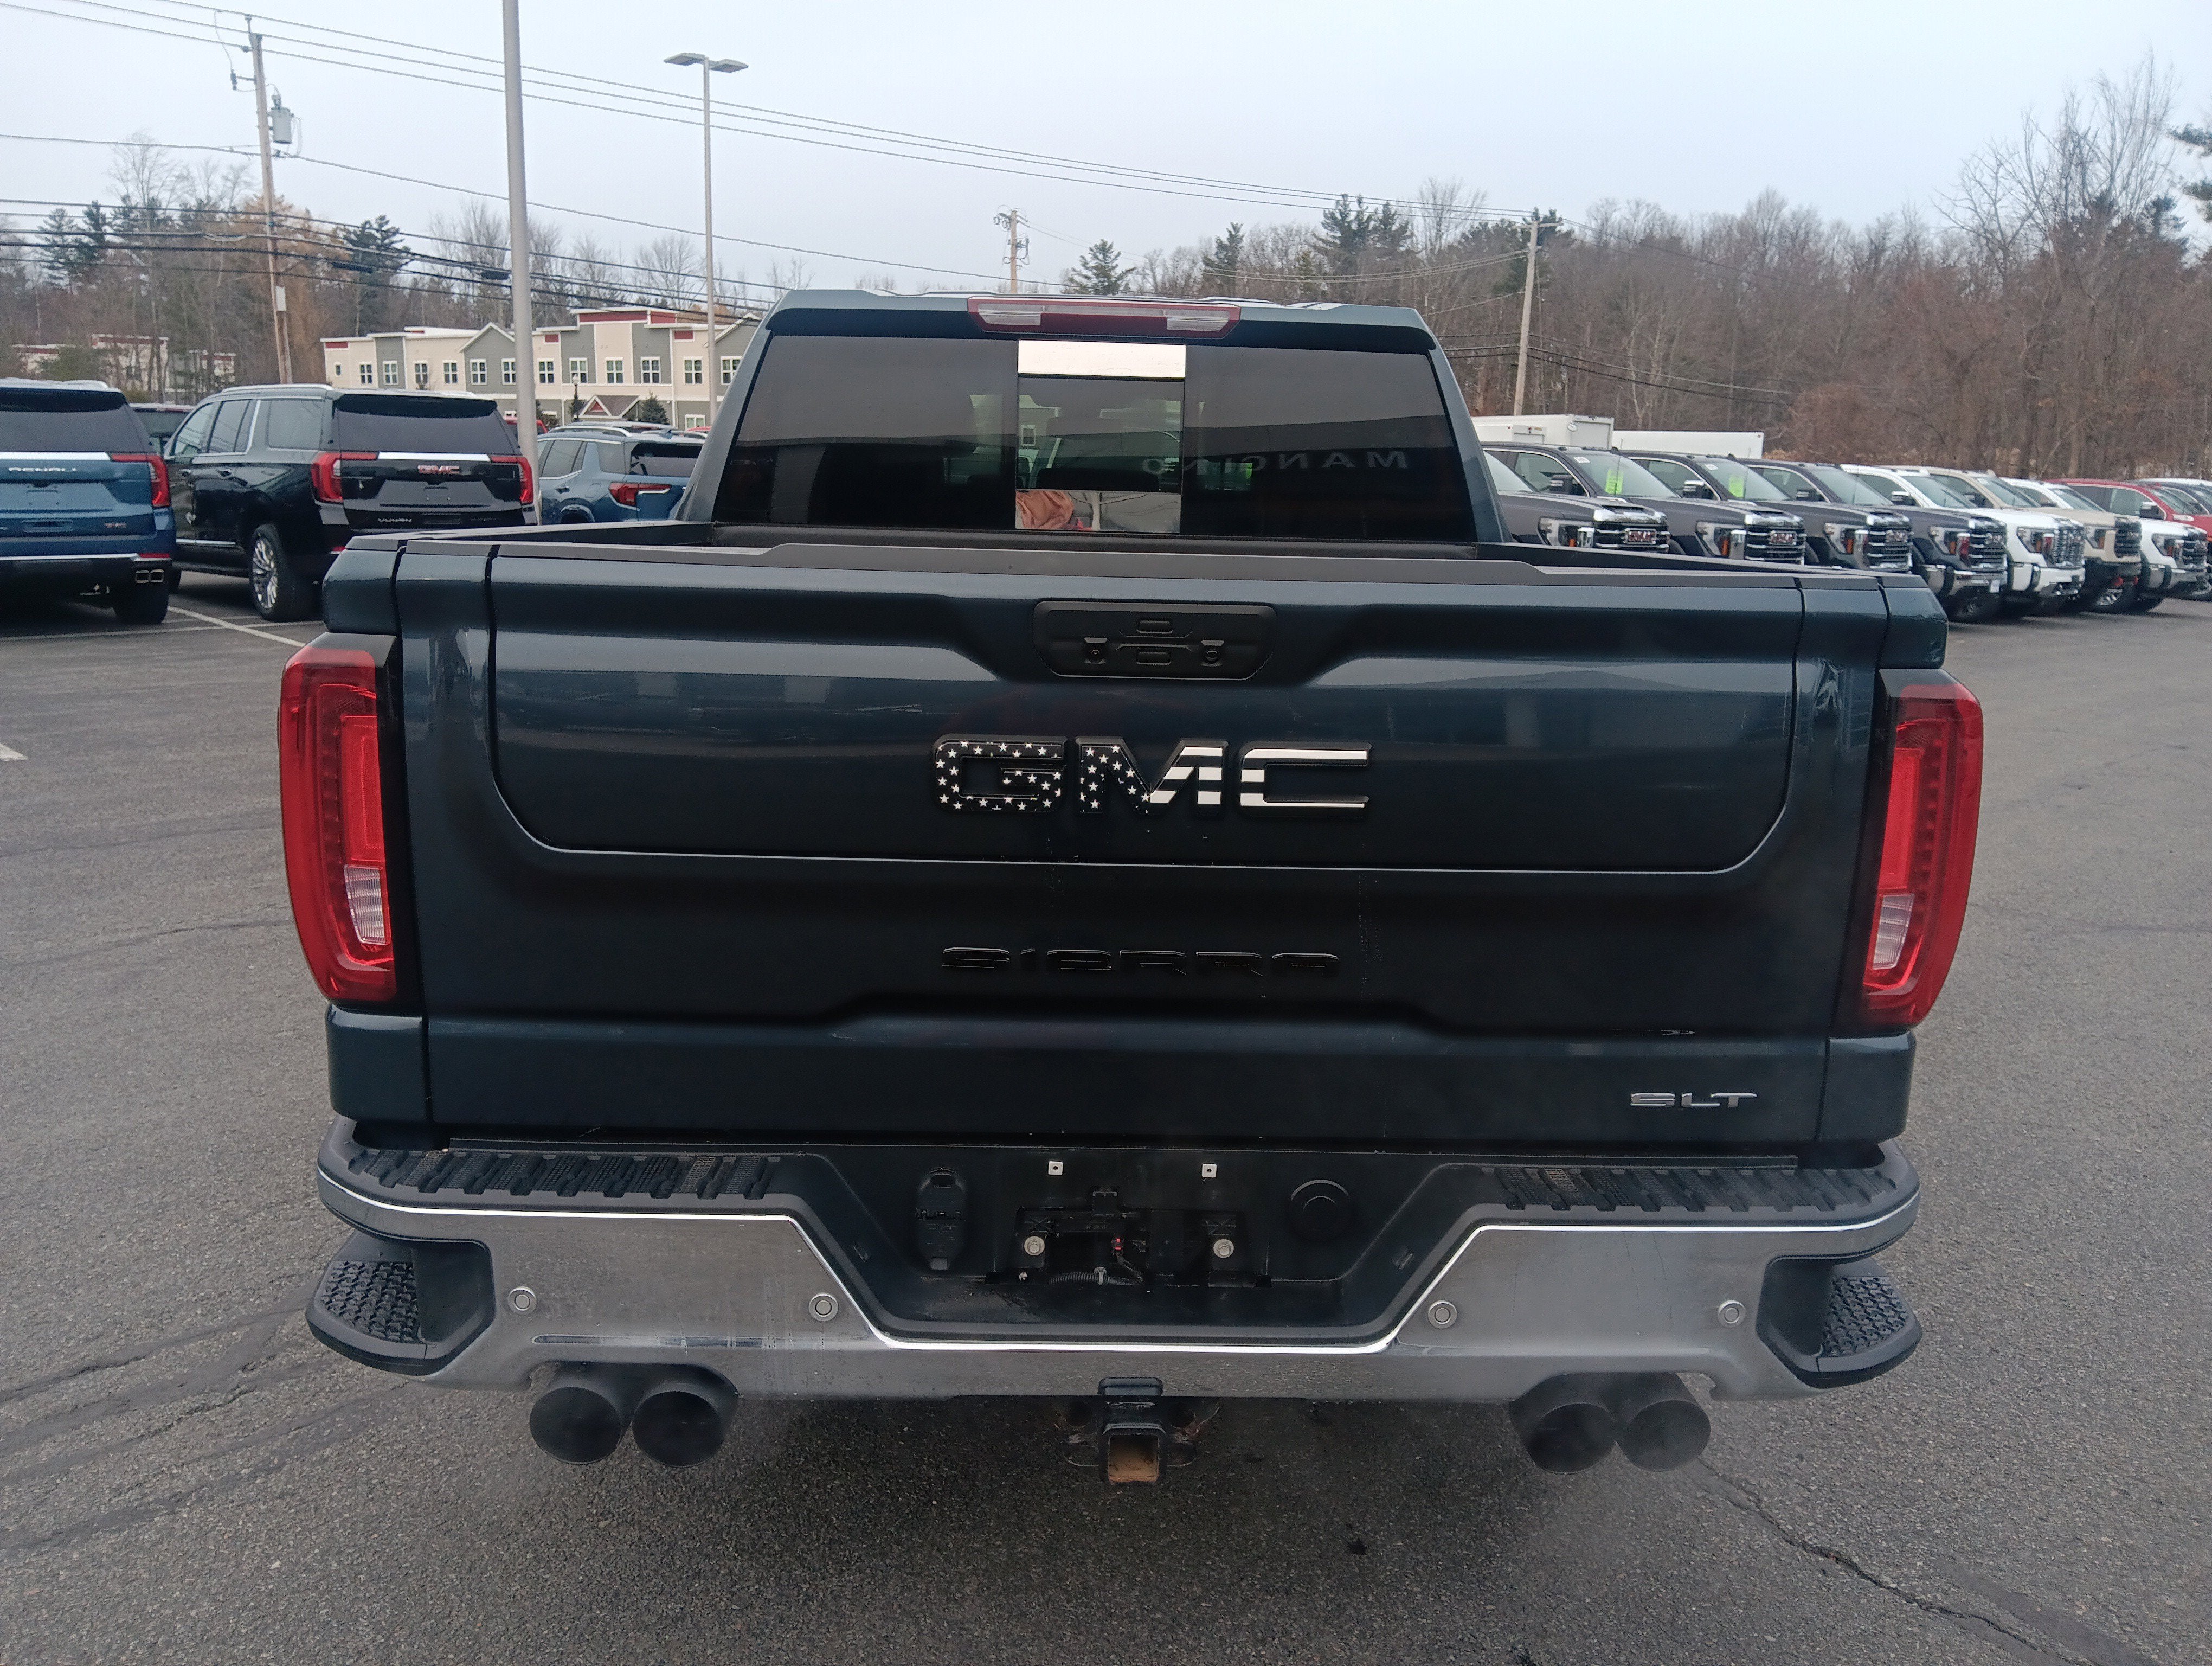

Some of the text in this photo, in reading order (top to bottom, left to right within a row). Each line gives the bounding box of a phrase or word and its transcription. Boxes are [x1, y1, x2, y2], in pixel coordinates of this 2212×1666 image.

[417, 465, 460, 475] GMC
[933, 733, 1373, 815] GMC
[942, 947, 1341, 976] SIERRA
[1630, 1092, 1757, 1108] SLT
